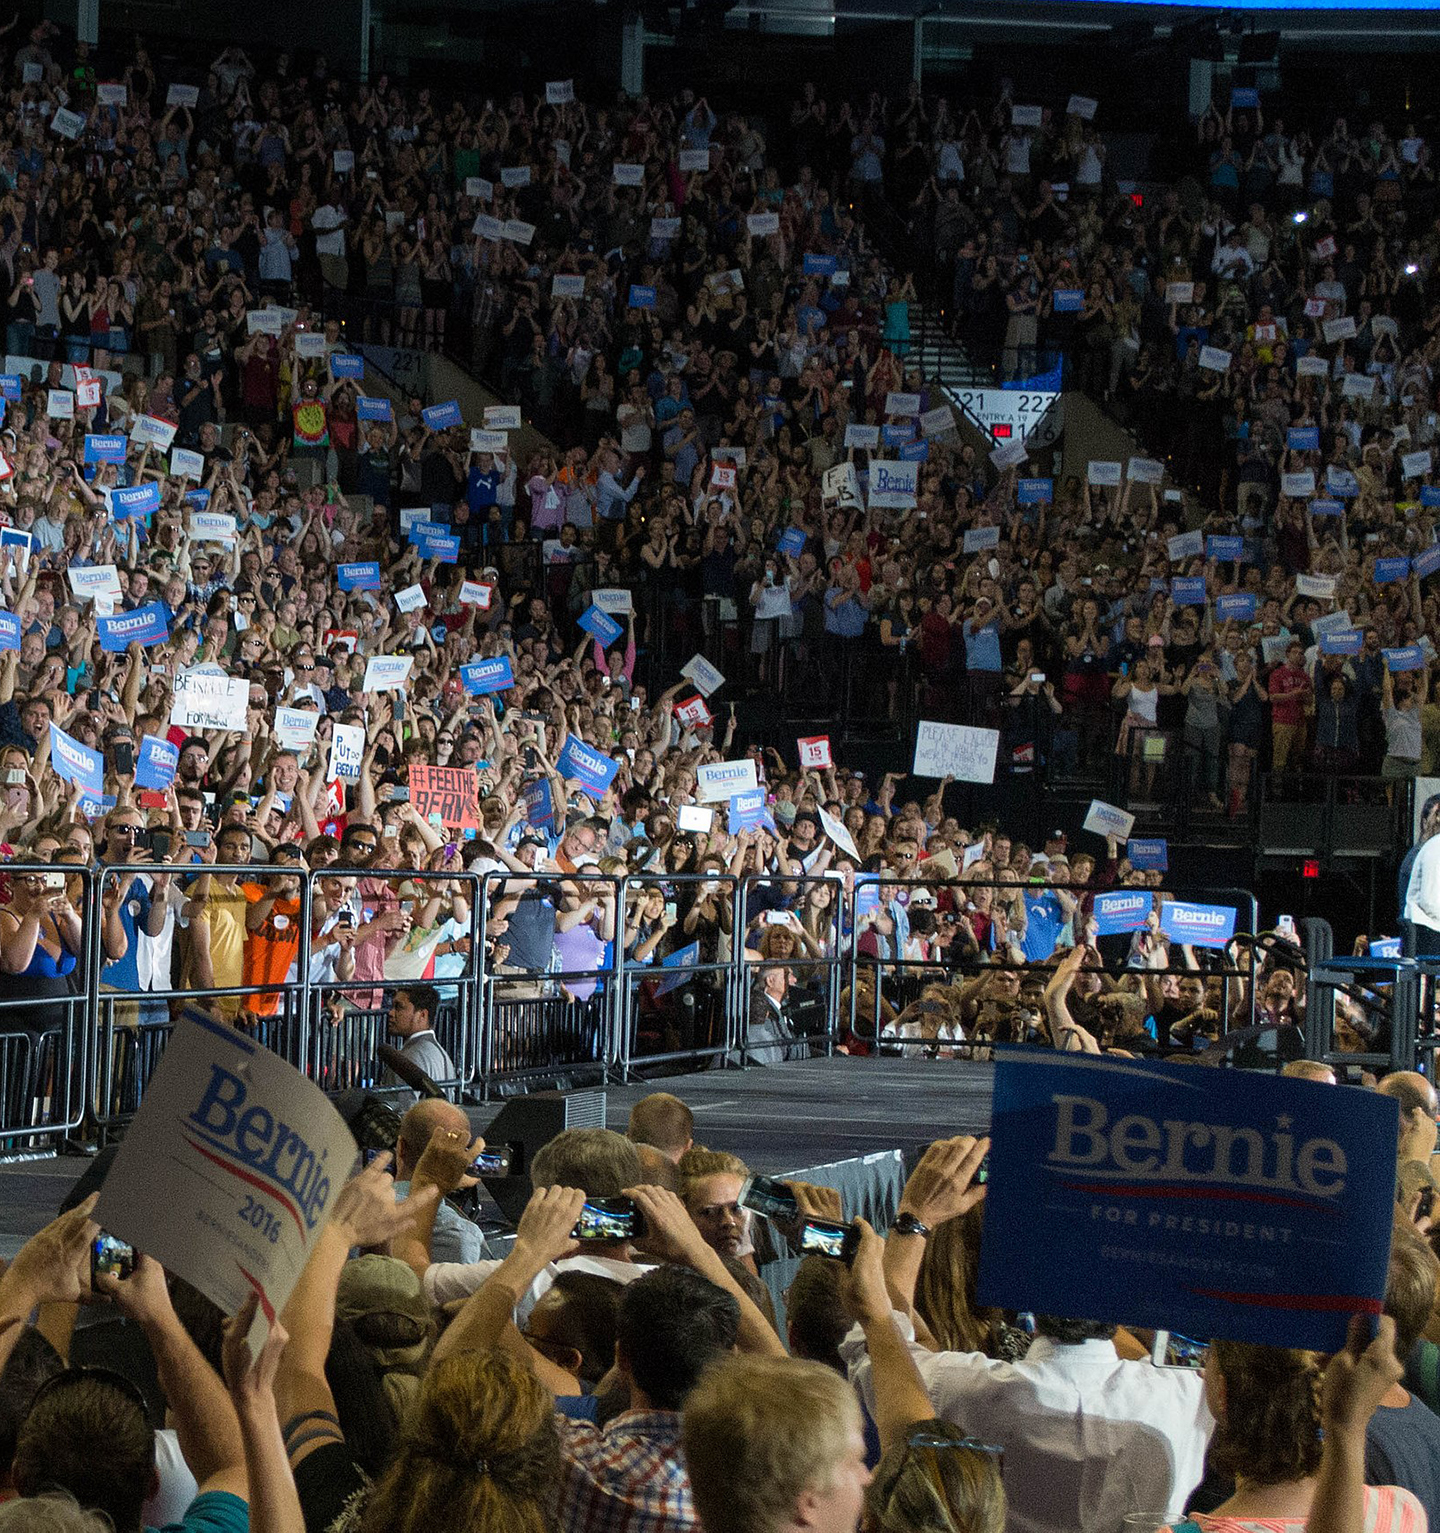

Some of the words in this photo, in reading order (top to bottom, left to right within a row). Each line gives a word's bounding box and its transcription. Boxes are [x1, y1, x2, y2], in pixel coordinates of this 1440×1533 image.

[141, 413, 170, 437] Bernie
[91, 438, 122, 451] Bernie
[119, 487, 153, 503] Bernie
[75, 570, 111, 583] Bernie
[342, 564, 374, 577] Bernie
[107, 611, 157, 633] Bernie
[371, 660, 405, 673] Bernie
[466, 661, 504, 678] Bernie
[685, 706, 700, 718] 15
[282, 714, 312, 729] Bernie
[56, 734, 95, 770] Bernie
[151, 745, 176, 766] Bern
[569, 740, 607, 777] Bernie
[808, 745, 822, 756] 15
[705, 766, 749, 781] Bernie
[83, 800, 112, 816] Bern
[1134, 842, 1161, 855] Bernie
[1101, 894, 1144, 913] Bernie
[1173, 907, 1226, 926] Bernie
[189, 1063, 331, 1230] Bernie
[1046, 1094, 1348, 1198] Bernie
[239, 1195, 284, 1244] 2016
[1091, 1204, 1140, 1225] FOR
[1148, 1211, 1292, 1244] PRESIDENT
